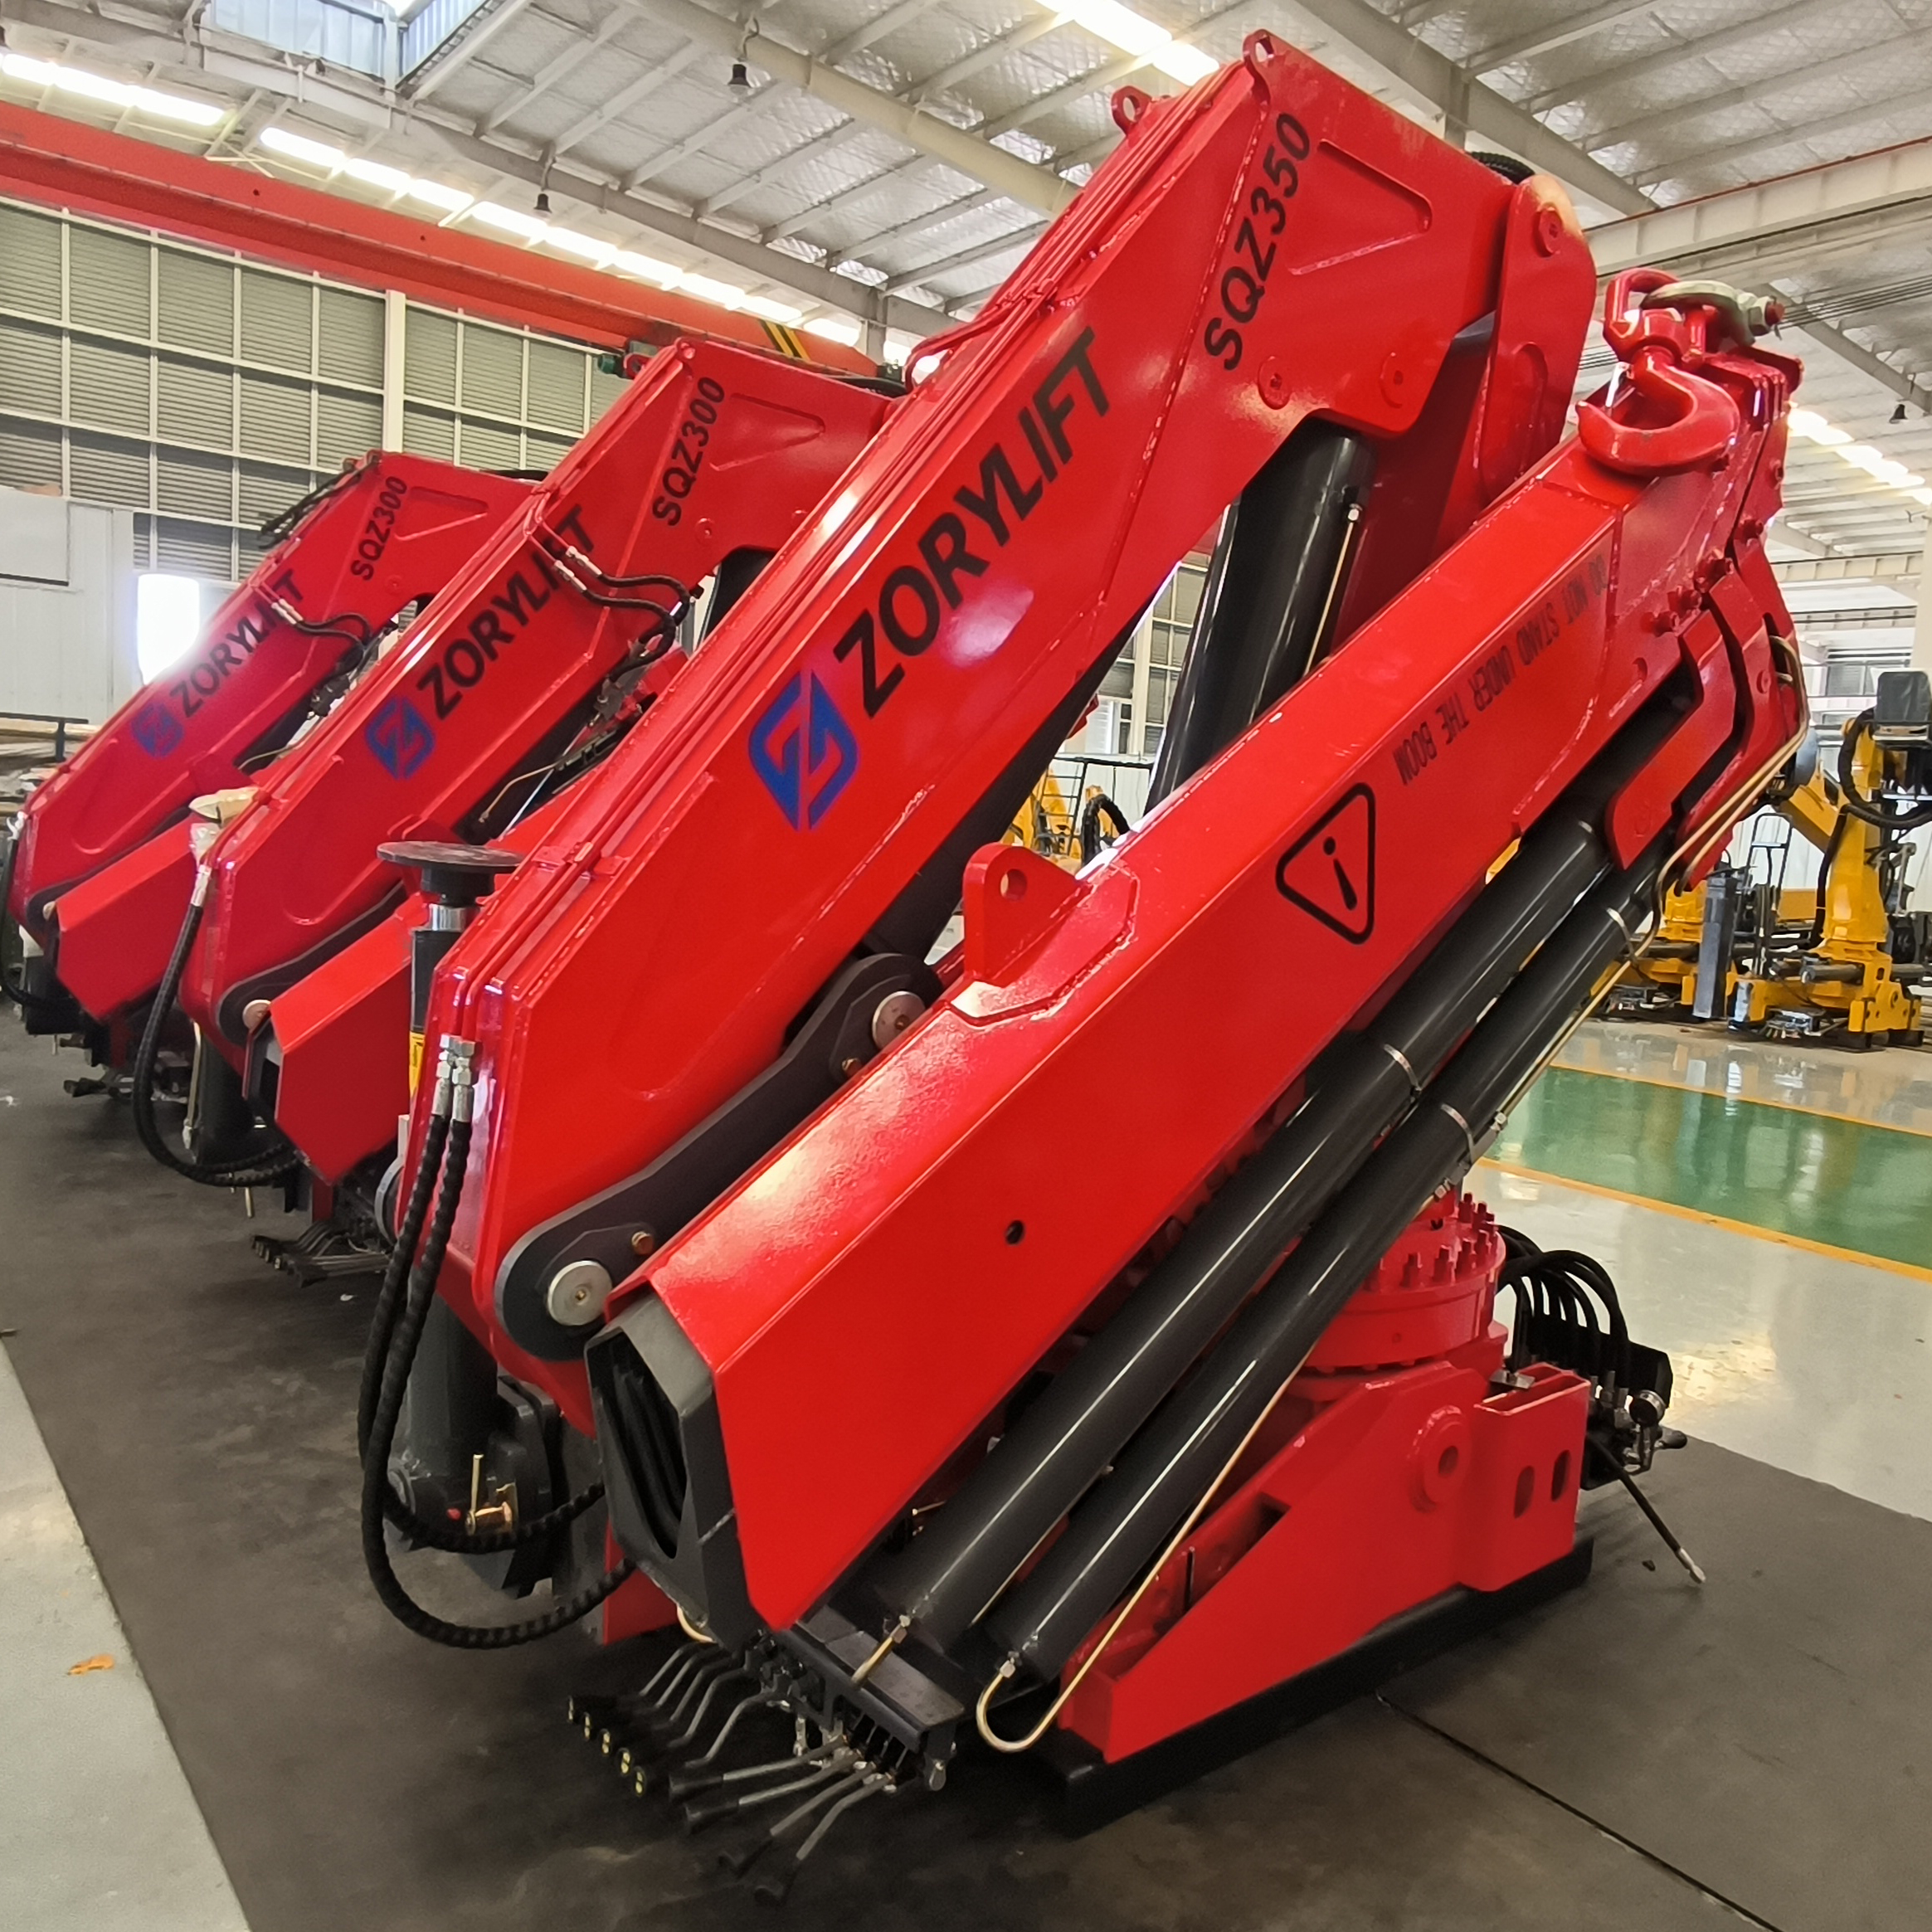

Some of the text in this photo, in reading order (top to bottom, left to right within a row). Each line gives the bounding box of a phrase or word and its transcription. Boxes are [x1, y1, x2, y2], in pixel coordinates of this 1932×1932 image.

[1204, 112, 1310, 371] SQZ350
[652, 377, 725, 527] SQZ300
[350, 475, 407, 581] SQZ300
[833, 326, 1110, 720] ZORYLIFT
[169, 568, 304, 718] ZORYLIT
[1468, 645, 1516, 712] UNDER
[1516, 602, 1560, 666] STAND
[1393, 721, 1438, 786] BOOM
[1435, 692, 1470, 745] THE
